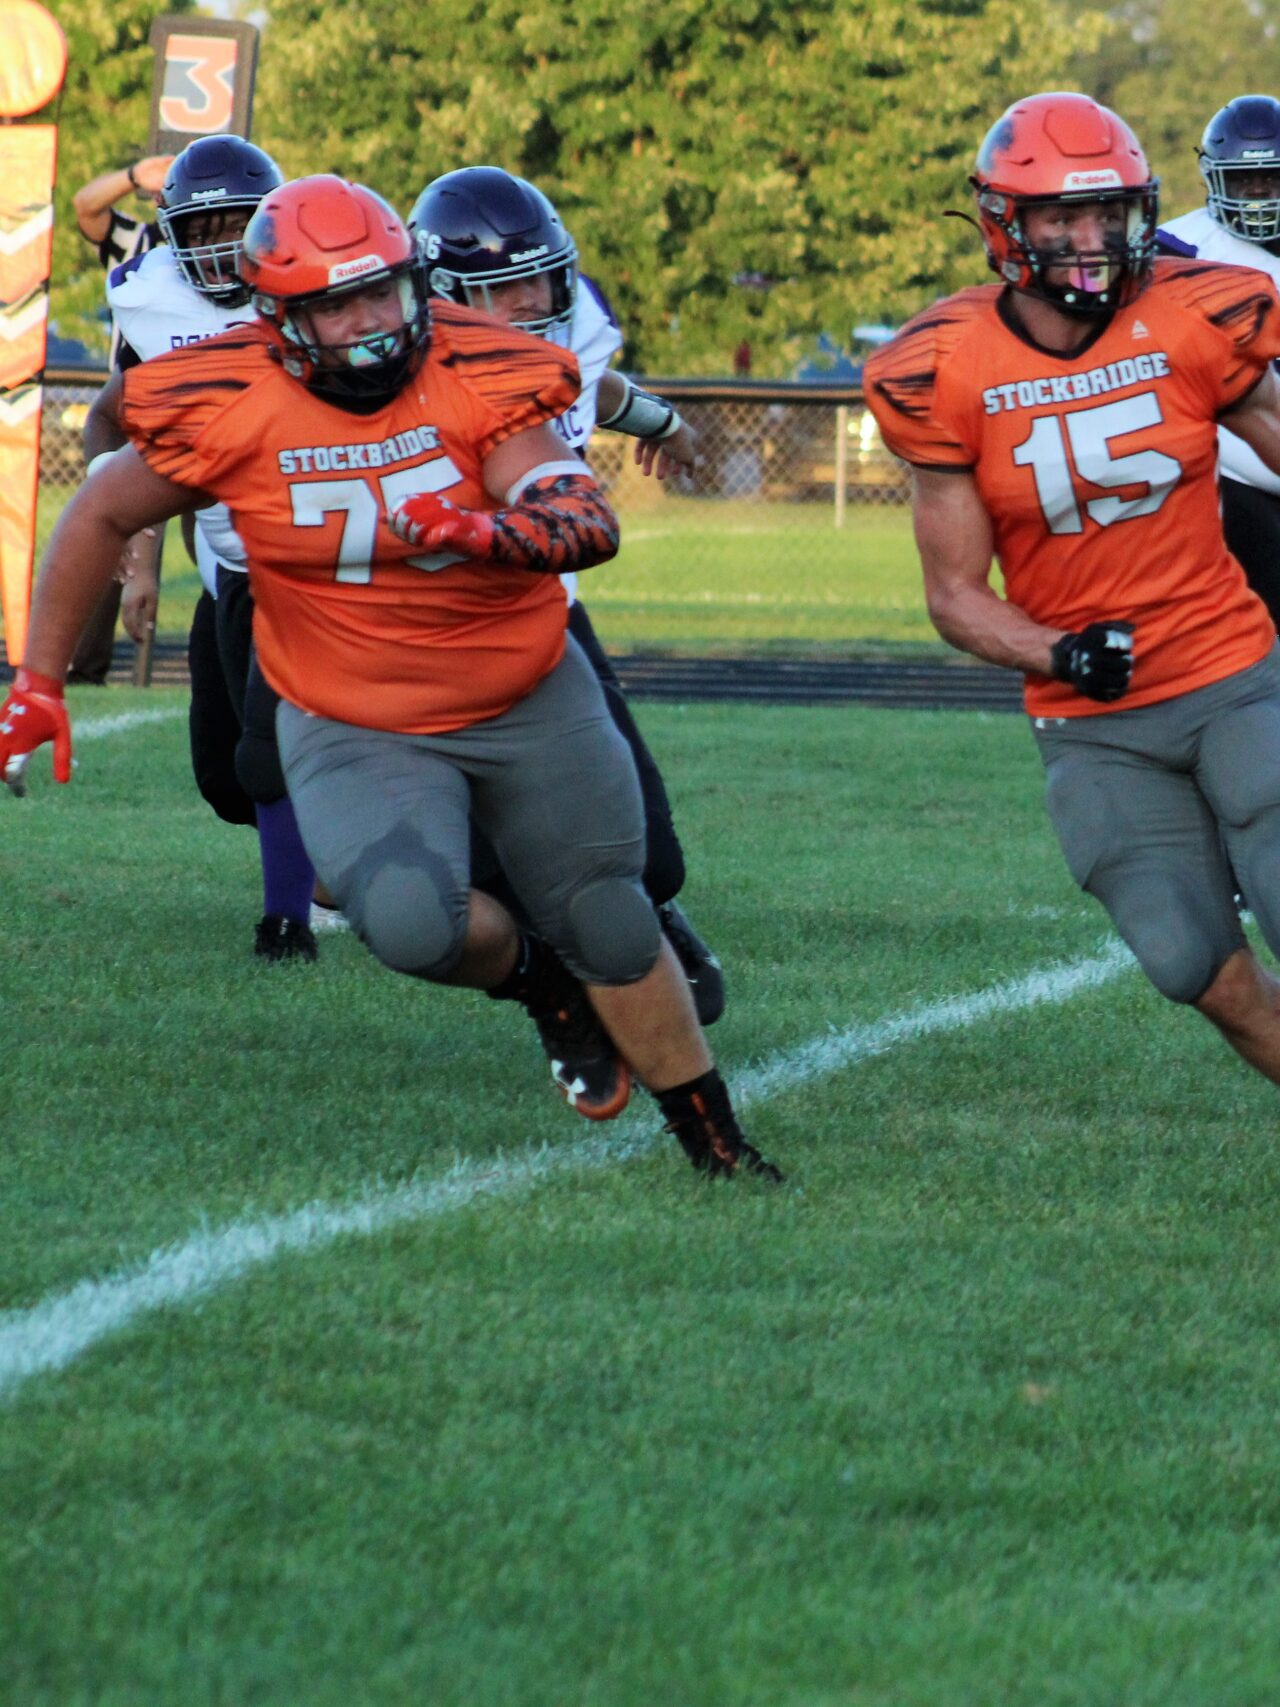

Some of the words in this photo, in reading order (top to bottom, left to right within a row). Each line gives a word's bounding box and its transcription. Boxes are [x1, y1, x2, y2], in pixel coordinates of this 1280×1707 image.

[159, 34, 238, 133] 3
[336, 258, 378, 278] Riddell
[982, 351, 1171, 415] STOCKBRIDGE
[277, 425, 443, 475] STOCKBRIDG
[1013, 390, 1184, 535] 15
